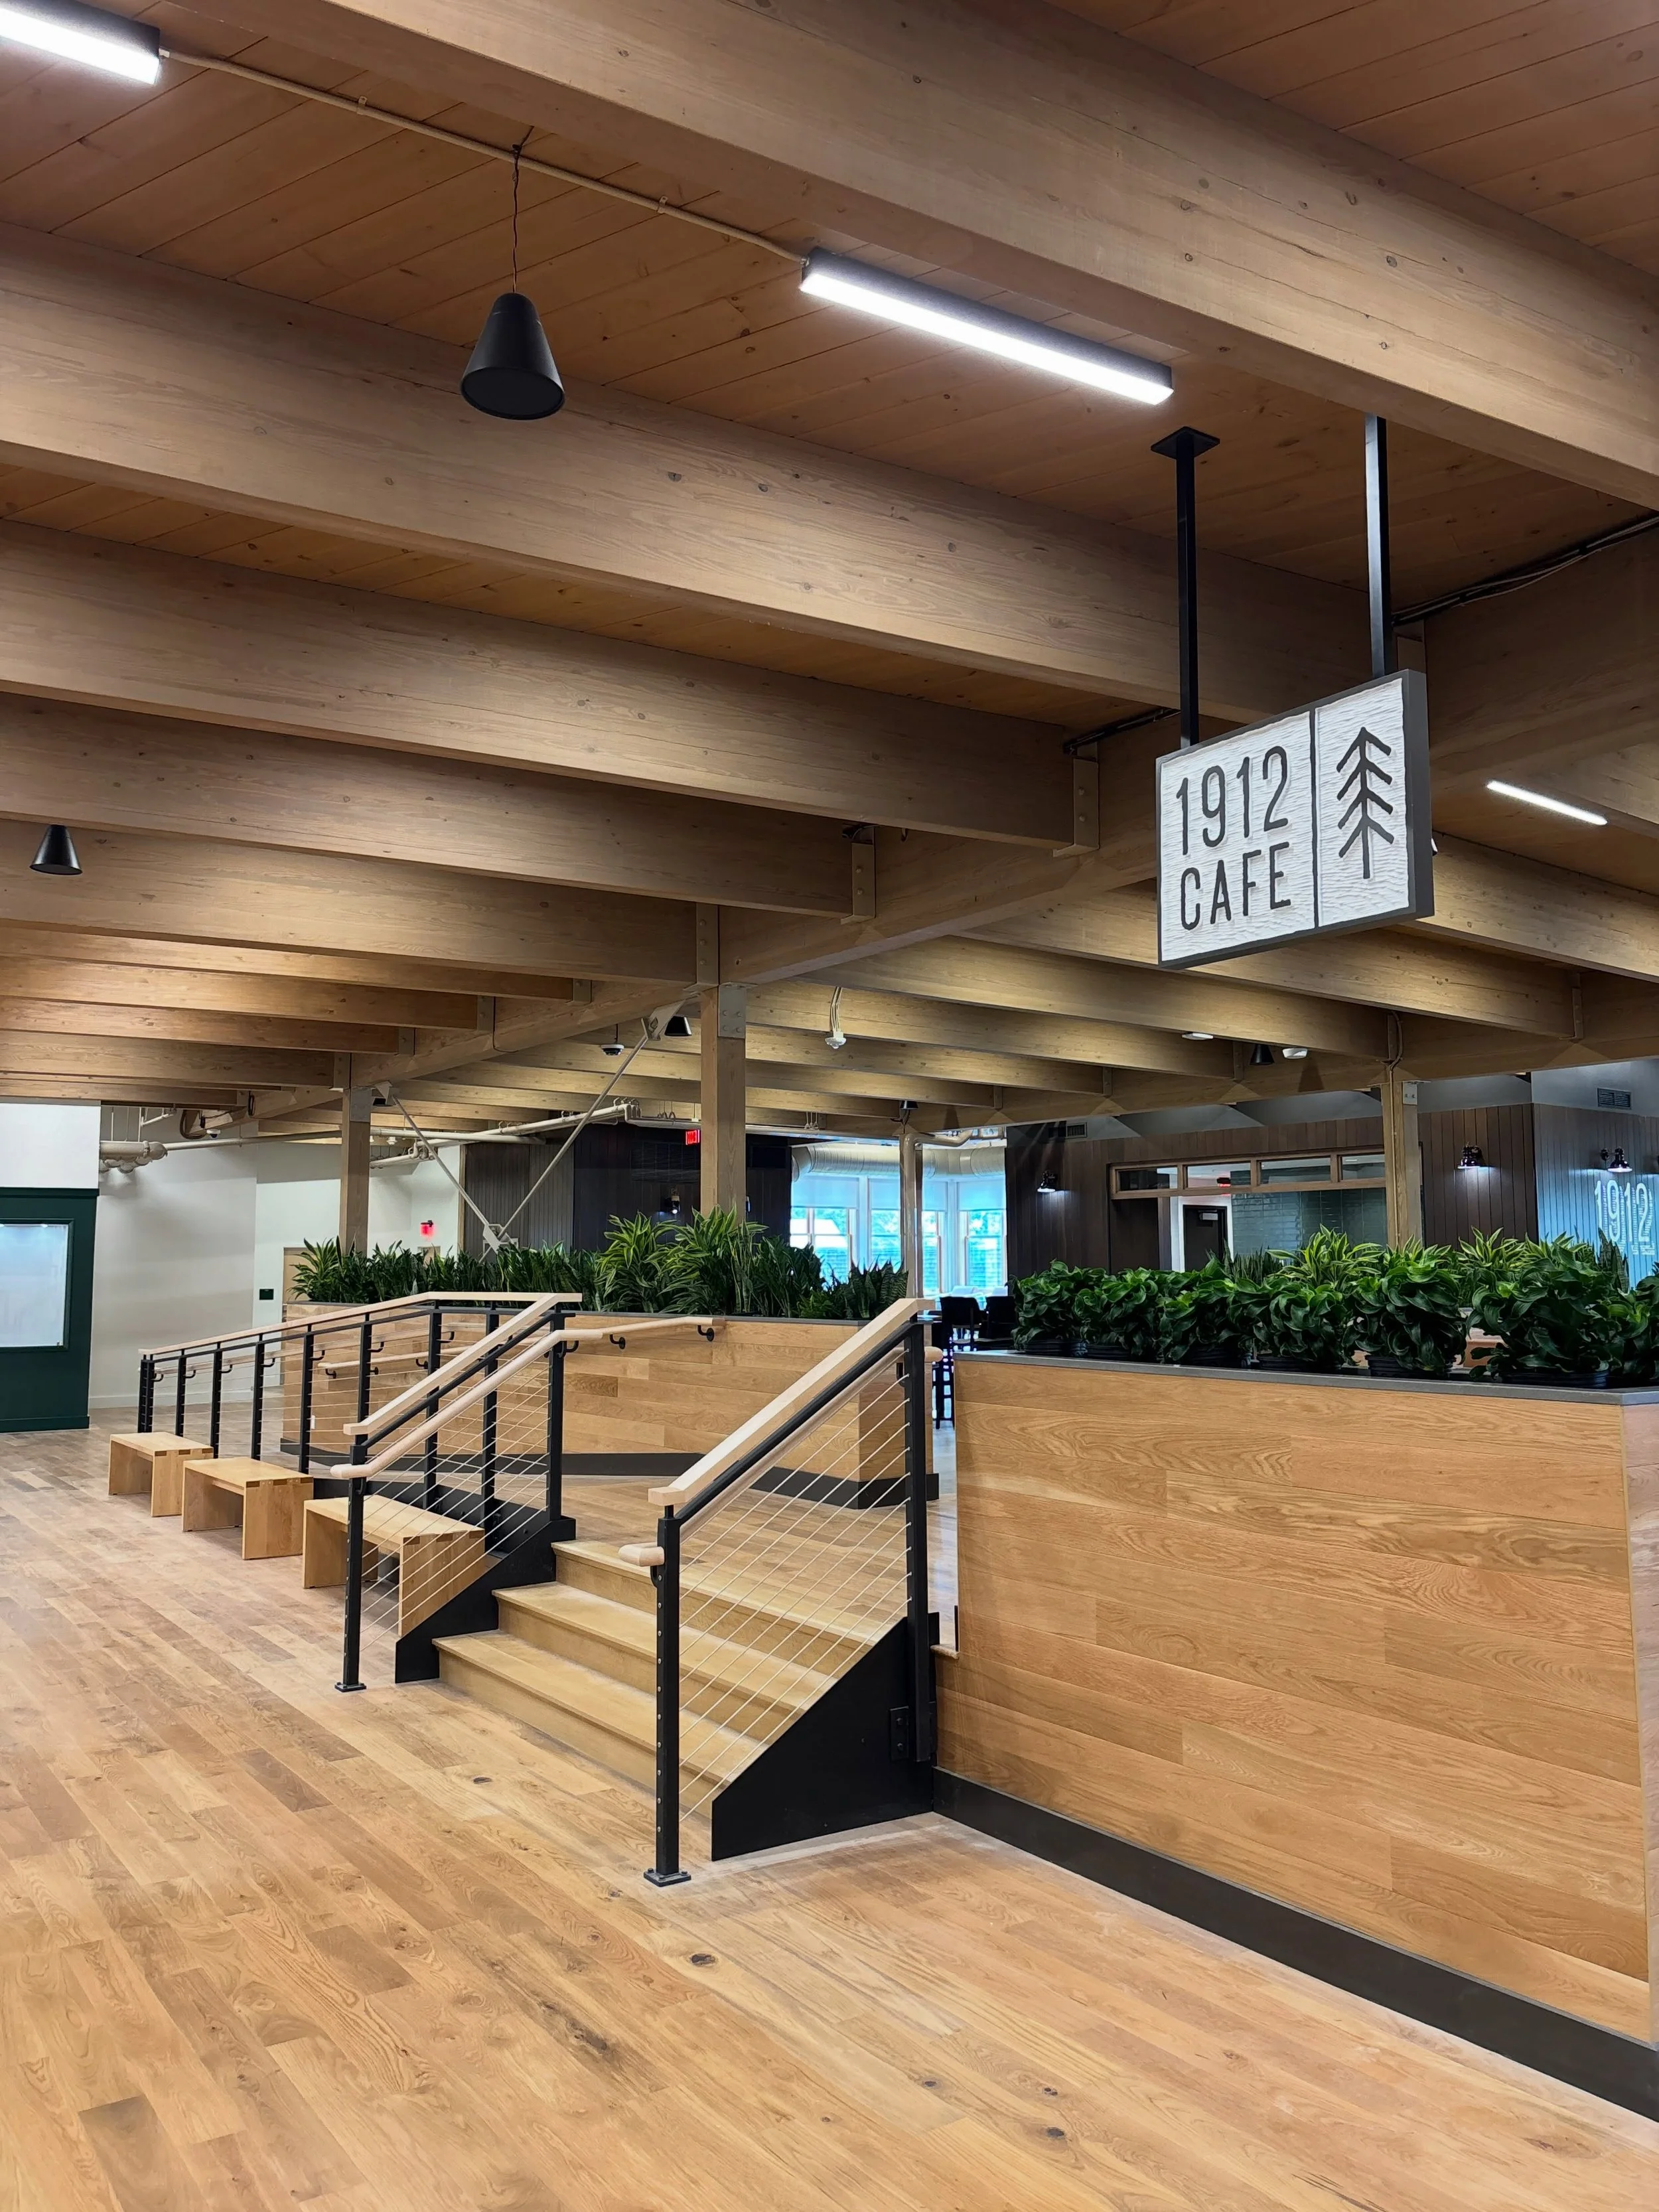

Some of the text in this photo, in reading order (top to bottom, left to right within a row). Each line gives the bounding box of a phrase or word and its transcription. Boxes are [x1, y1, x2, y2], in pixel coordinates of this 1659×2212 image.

[1177, 746, 1288, 855] 1912
[1181, 842, 1291, 930] CAFE
[1595, 1180, 1650, 1242] 1912
